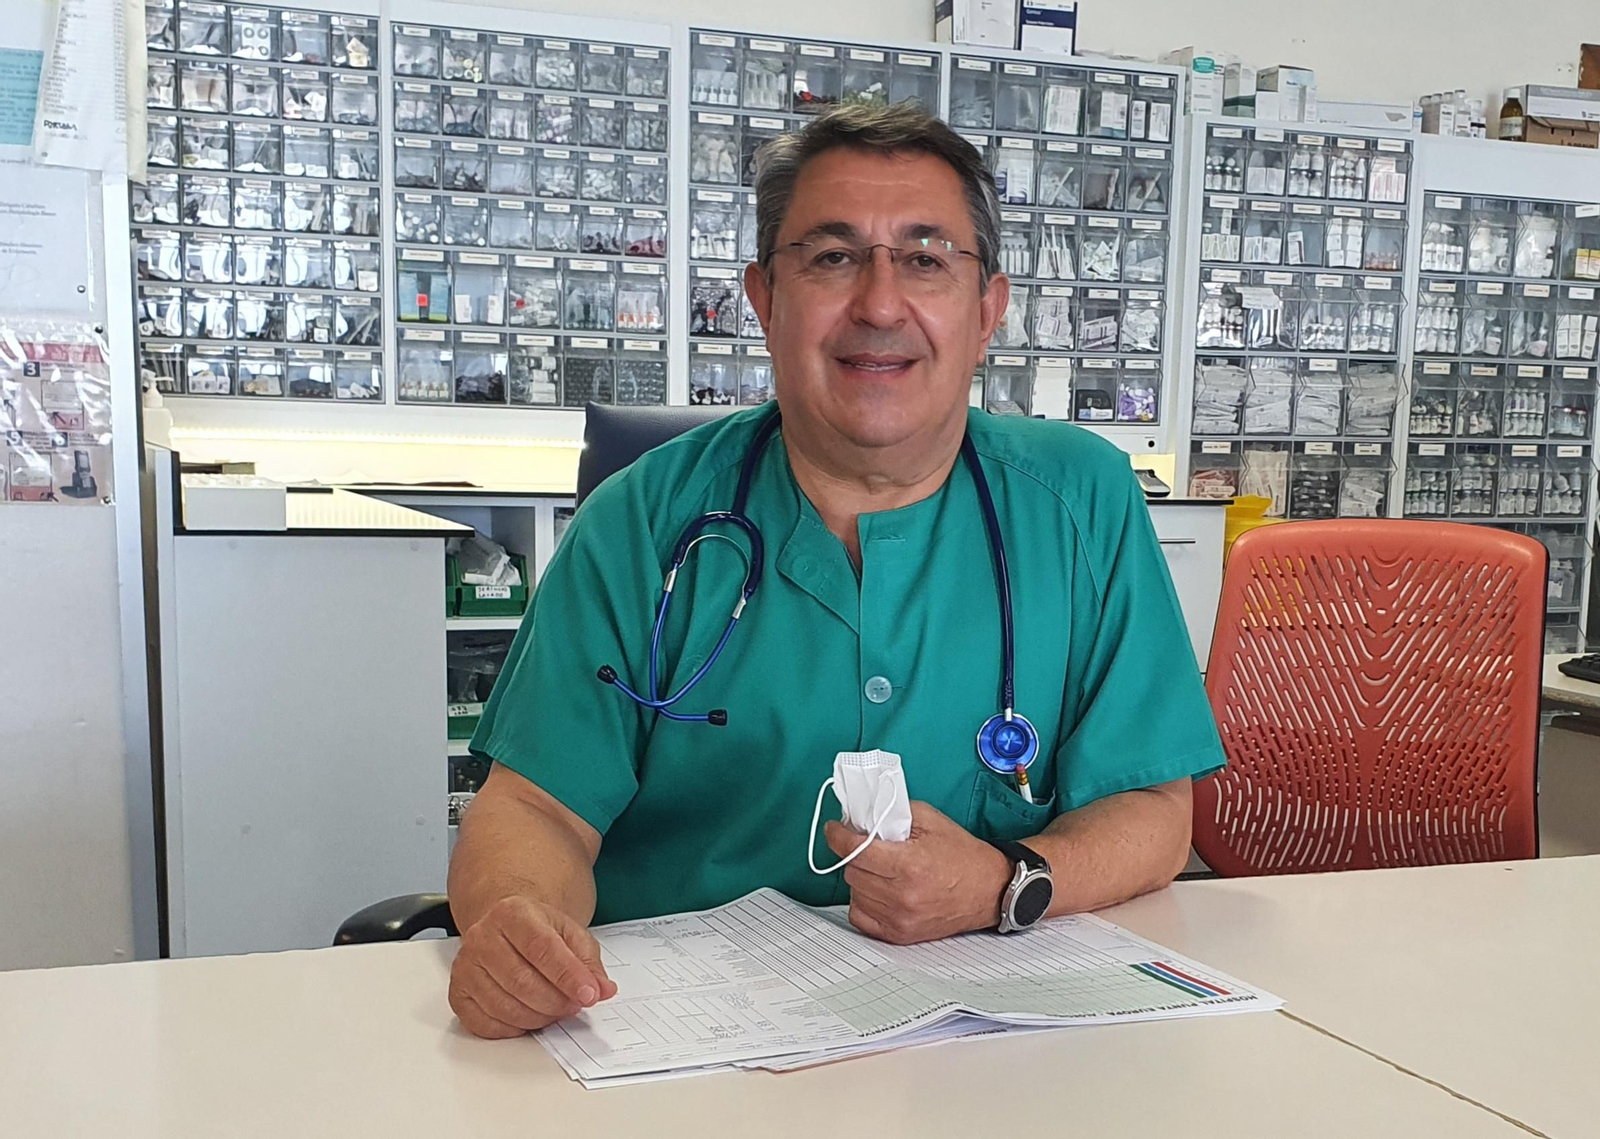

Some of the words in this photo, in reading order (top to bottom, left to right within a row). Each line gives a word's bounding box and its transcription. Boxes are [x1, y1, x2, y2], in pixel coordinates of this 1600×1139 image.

[1198, 994, 1259, 1006] HOSPITAL
[1107, 1006, 1156, 1017] EUROPA
[1155, 1001, 1199, 1011] PUNTA
[857, 1018, 913, 1038] INTENSIVA
